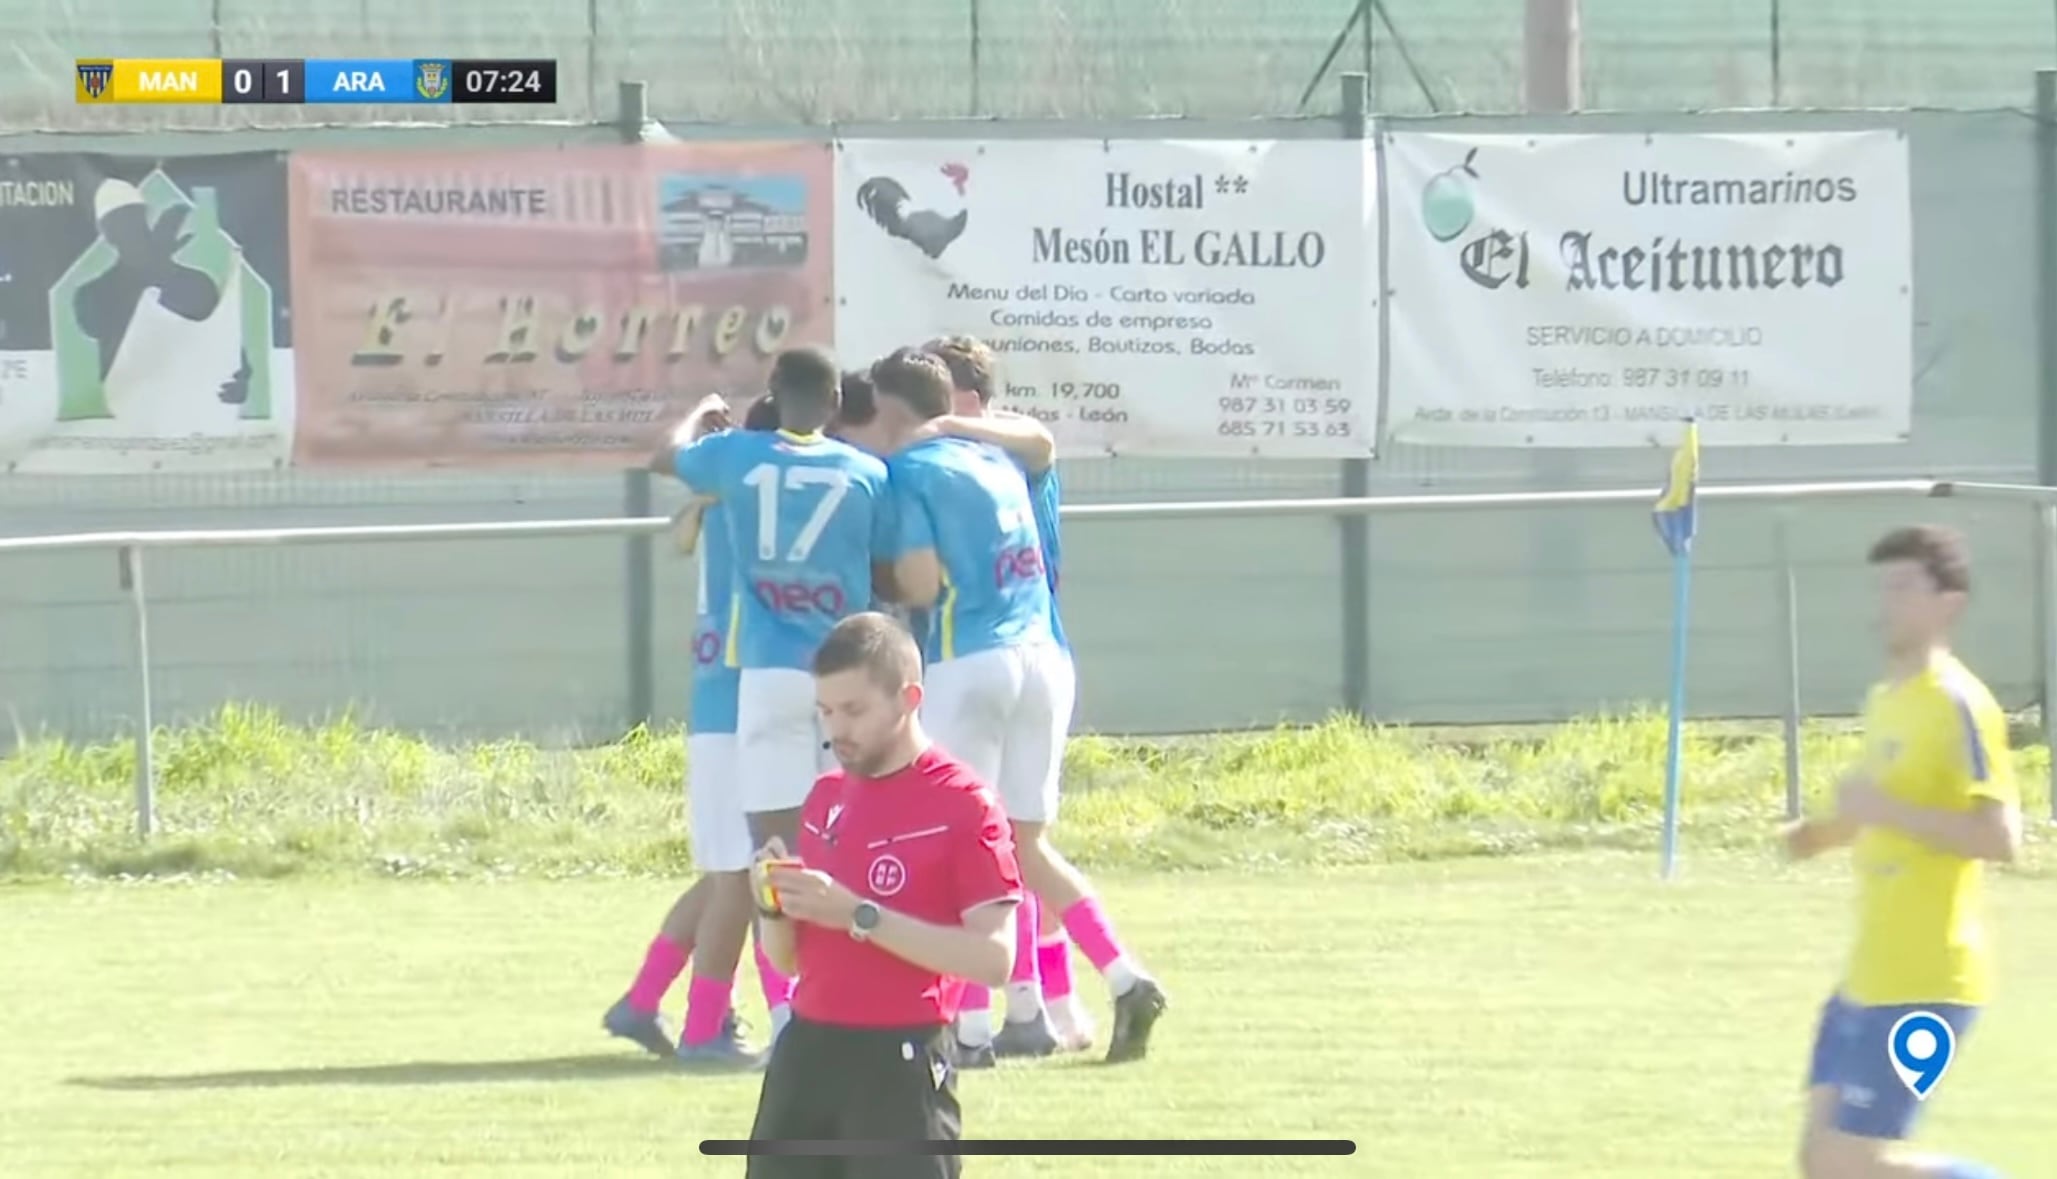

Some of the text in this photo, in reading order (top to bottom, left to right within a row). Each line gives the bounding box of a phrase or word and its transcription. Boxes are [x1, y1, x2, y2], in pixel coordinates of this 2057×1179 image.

[1105, 172, 1203, 209] Hostal
[1622, 170, 1857, 205] Ultramarinos
[331, 187, 547, 214] RESTAURANTE
[1032, 227, 1326, 268] Mesón EL GALLO
[1460, 228, 1844, 292] El Aceitunero
[1015, 285, 1048, 301] del
[1110, 285, 1167, 303] Carta
[1175, 289, 1256, 305] variada
[990, 309, 1212, 331] Comidas de empresa
[1088, 337, 1182, 356] Bautizos,
[1190, 337, 1255, 356] Bodas
[1526, 326, 1763, 348] SERVICIO A DOMICILIO
[1264, 374, 1342, 390] Carmen
[1623, 368, 1661, 388] 987
[1665, 368, 1690, 388] 31
[1731, 370, 1749, 388] 11
[1052, 382, 1120, 399] 19,700
[1079, 406, 1128, 422] León
[1218, 397, 1352, 414] 987 31 03 59
[1218, 421, 1352, 437] 685 71 53 63
[741, 462, 849, 561] 17
[755, 579, 845, 615] neo
